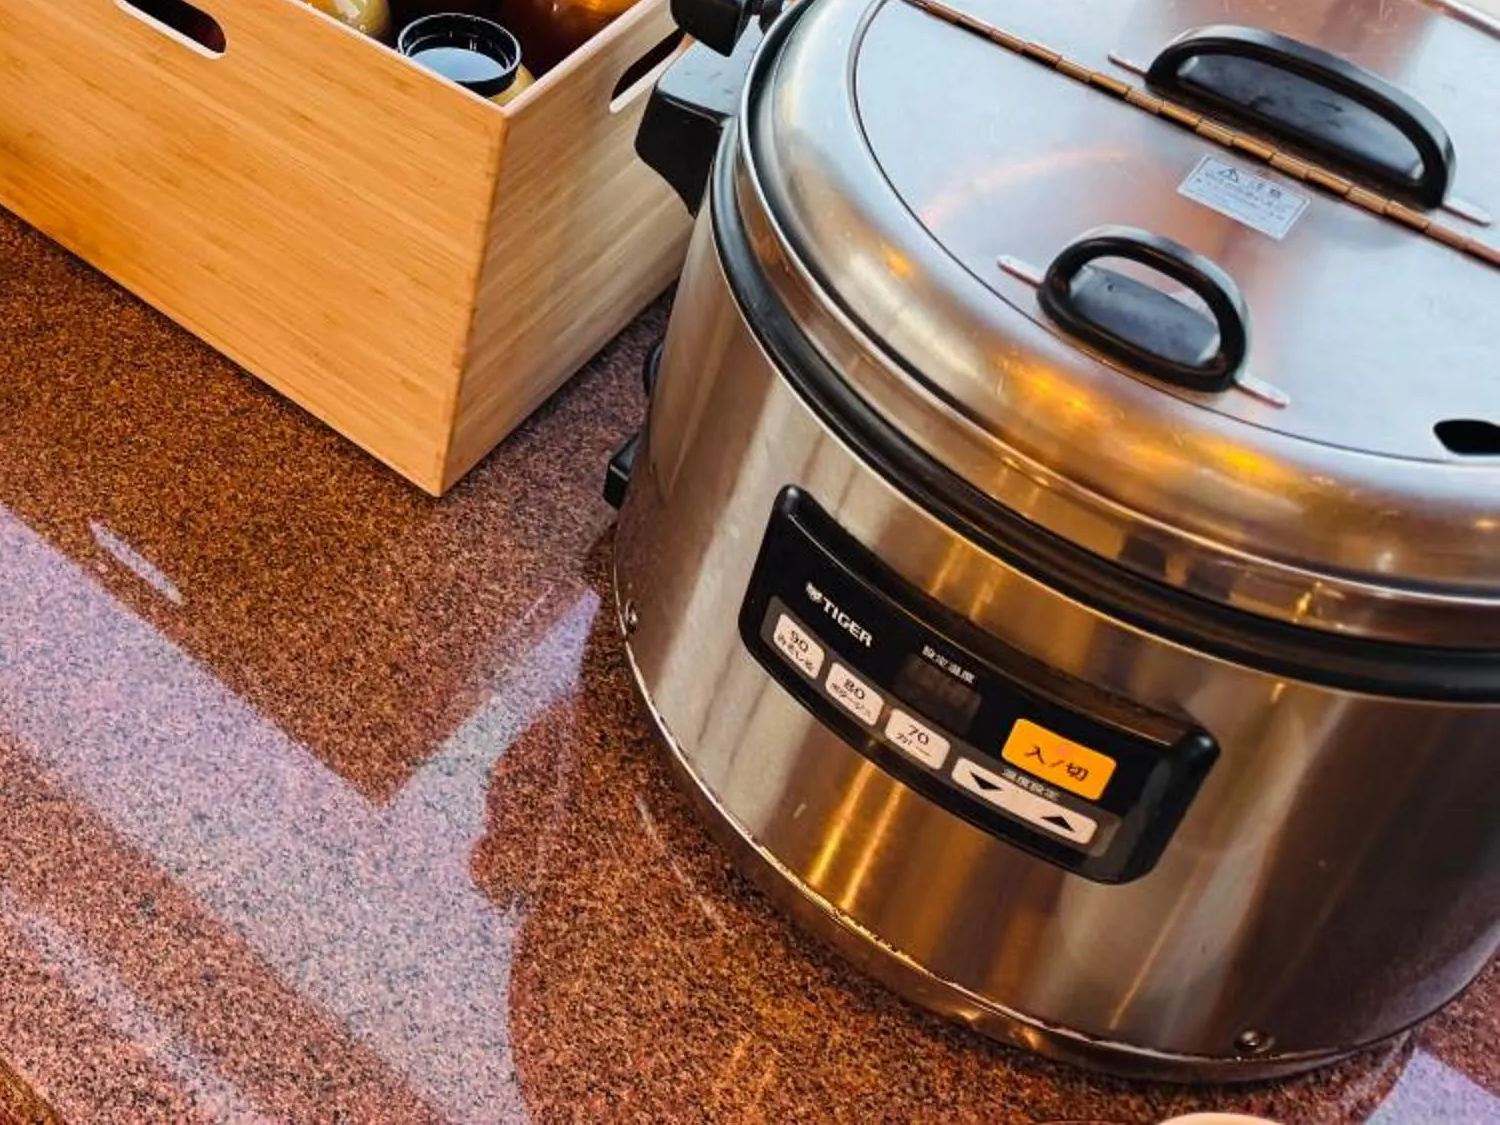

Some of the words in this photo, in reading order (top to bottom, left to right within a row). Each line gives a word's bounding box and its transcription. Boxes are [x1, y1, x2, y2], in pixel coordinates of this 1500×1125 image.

[821, 596, 874, 648] TIGER
[788, 629, 810, 653] 90
[842, 676, 866, 701] 80
[907, 724, 930, 746] 70
